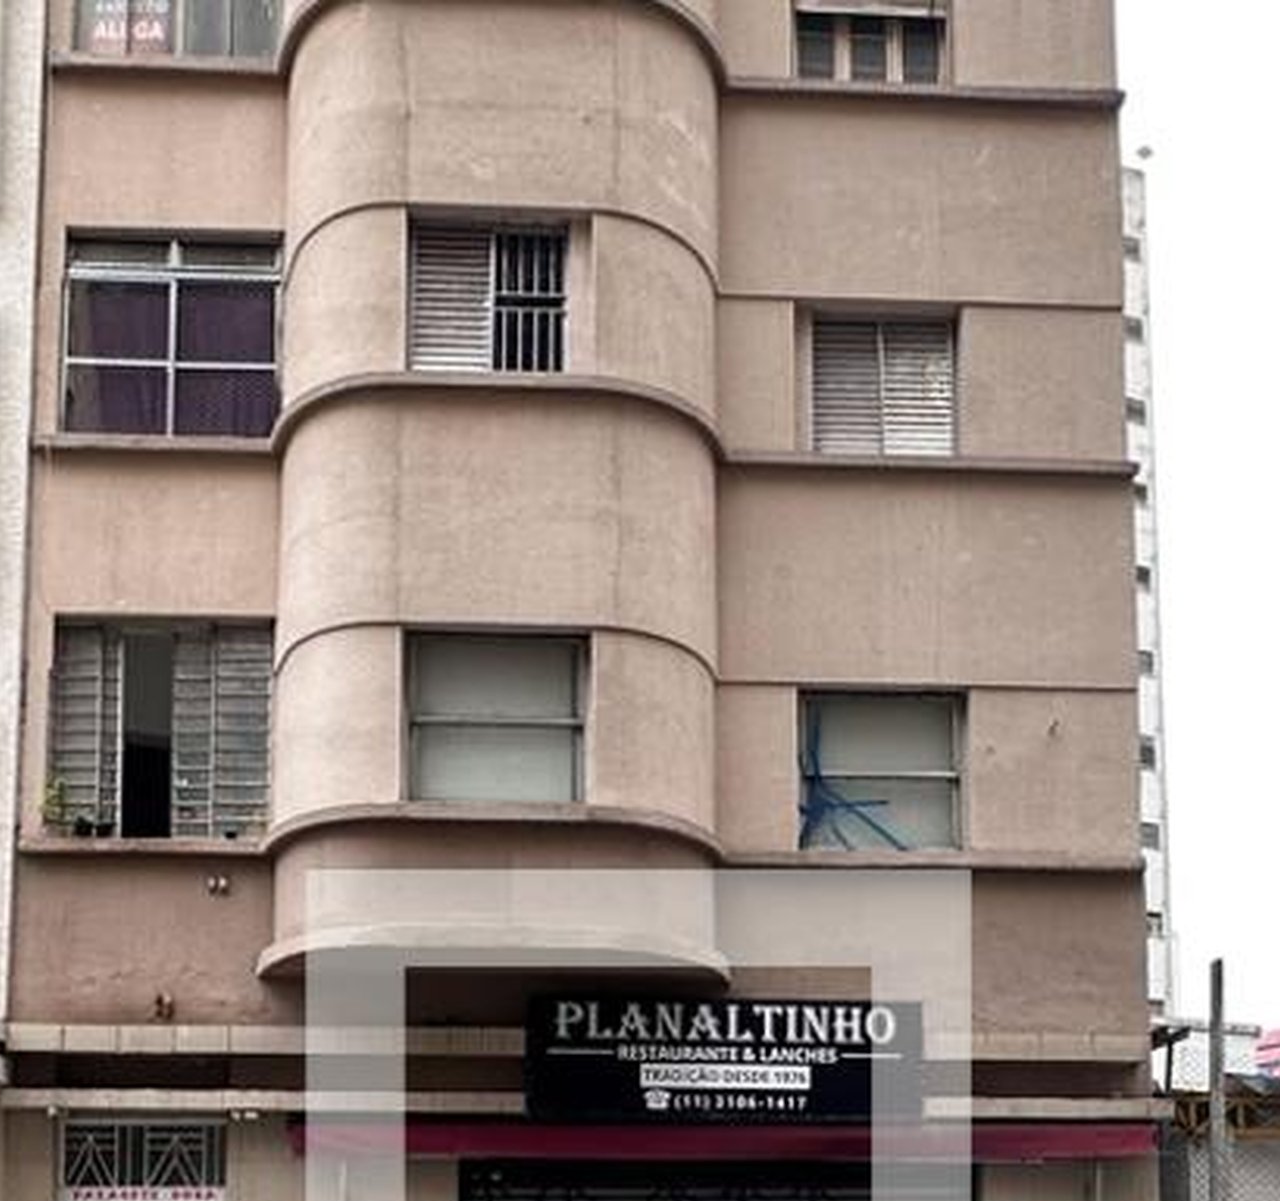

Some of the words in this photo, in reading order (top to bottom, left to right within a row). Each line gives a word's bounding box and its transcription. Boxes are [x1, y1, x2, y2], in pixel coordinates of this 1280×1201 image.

[554, 1001, 896, 1045] PLANALTINHO
[618, 1044, 739, 1061] RESTAURANTE
[743, 1046, 756, 1061] &
[759, 1046, 839, 1064] LANCHES
